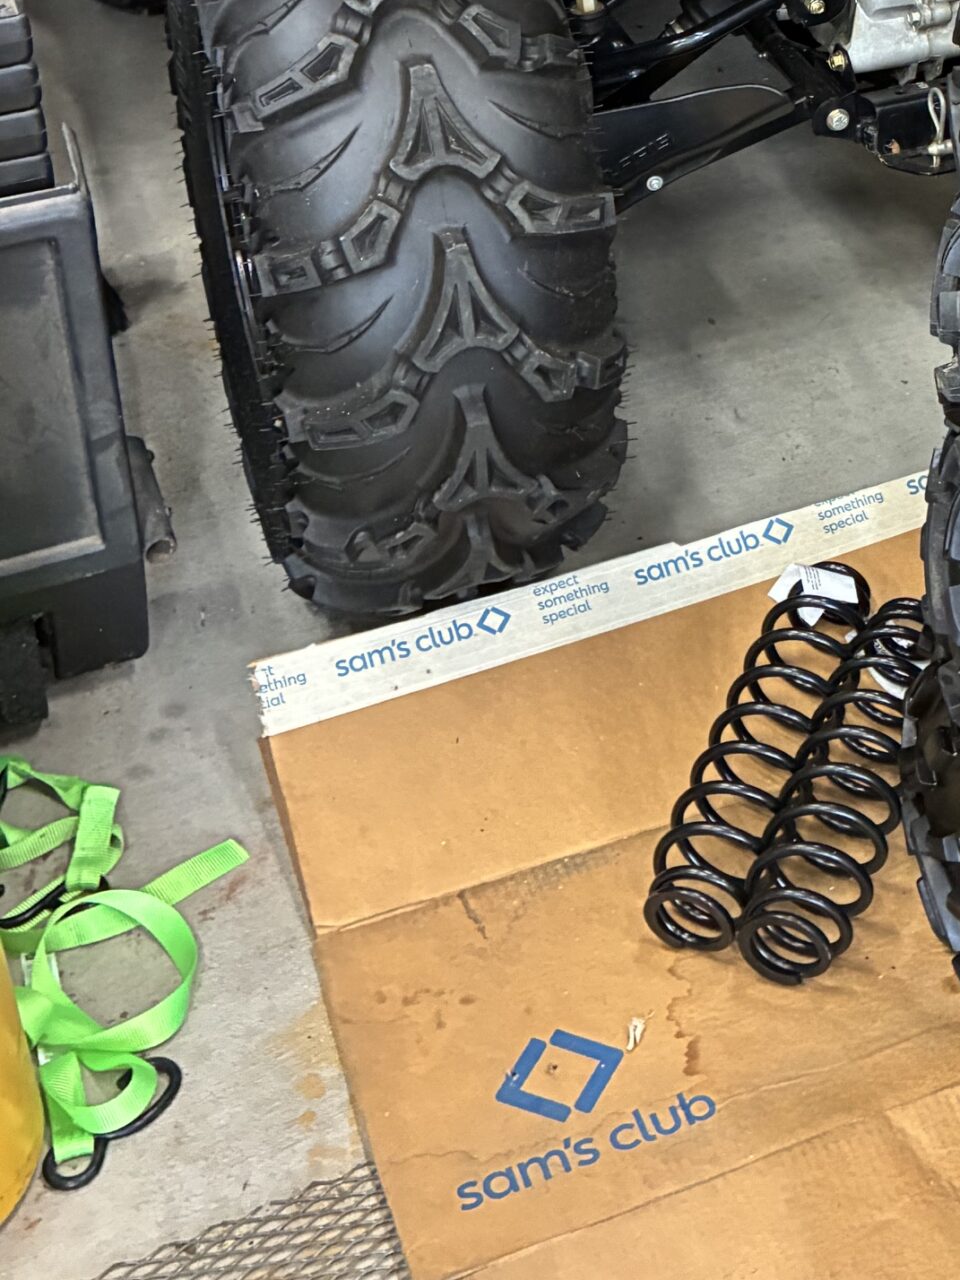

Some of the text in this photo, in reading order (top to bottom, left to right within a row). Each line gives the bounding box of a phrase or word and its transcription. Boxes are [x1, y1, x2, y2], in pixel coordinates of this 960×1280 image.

[817, 491, 884, 521] something
[822, 511, 869, 535] special
[634, 530, 760, 586] sam's club
[532, 574, 580, 597] expect
[537, 580, 610, 611] something
[542, 600, 593, 625] special
[335, 619, 473, 677] sam's club
[259, 672, 307, 694] ething
[456, 1091, 717, 1211] sam's club
